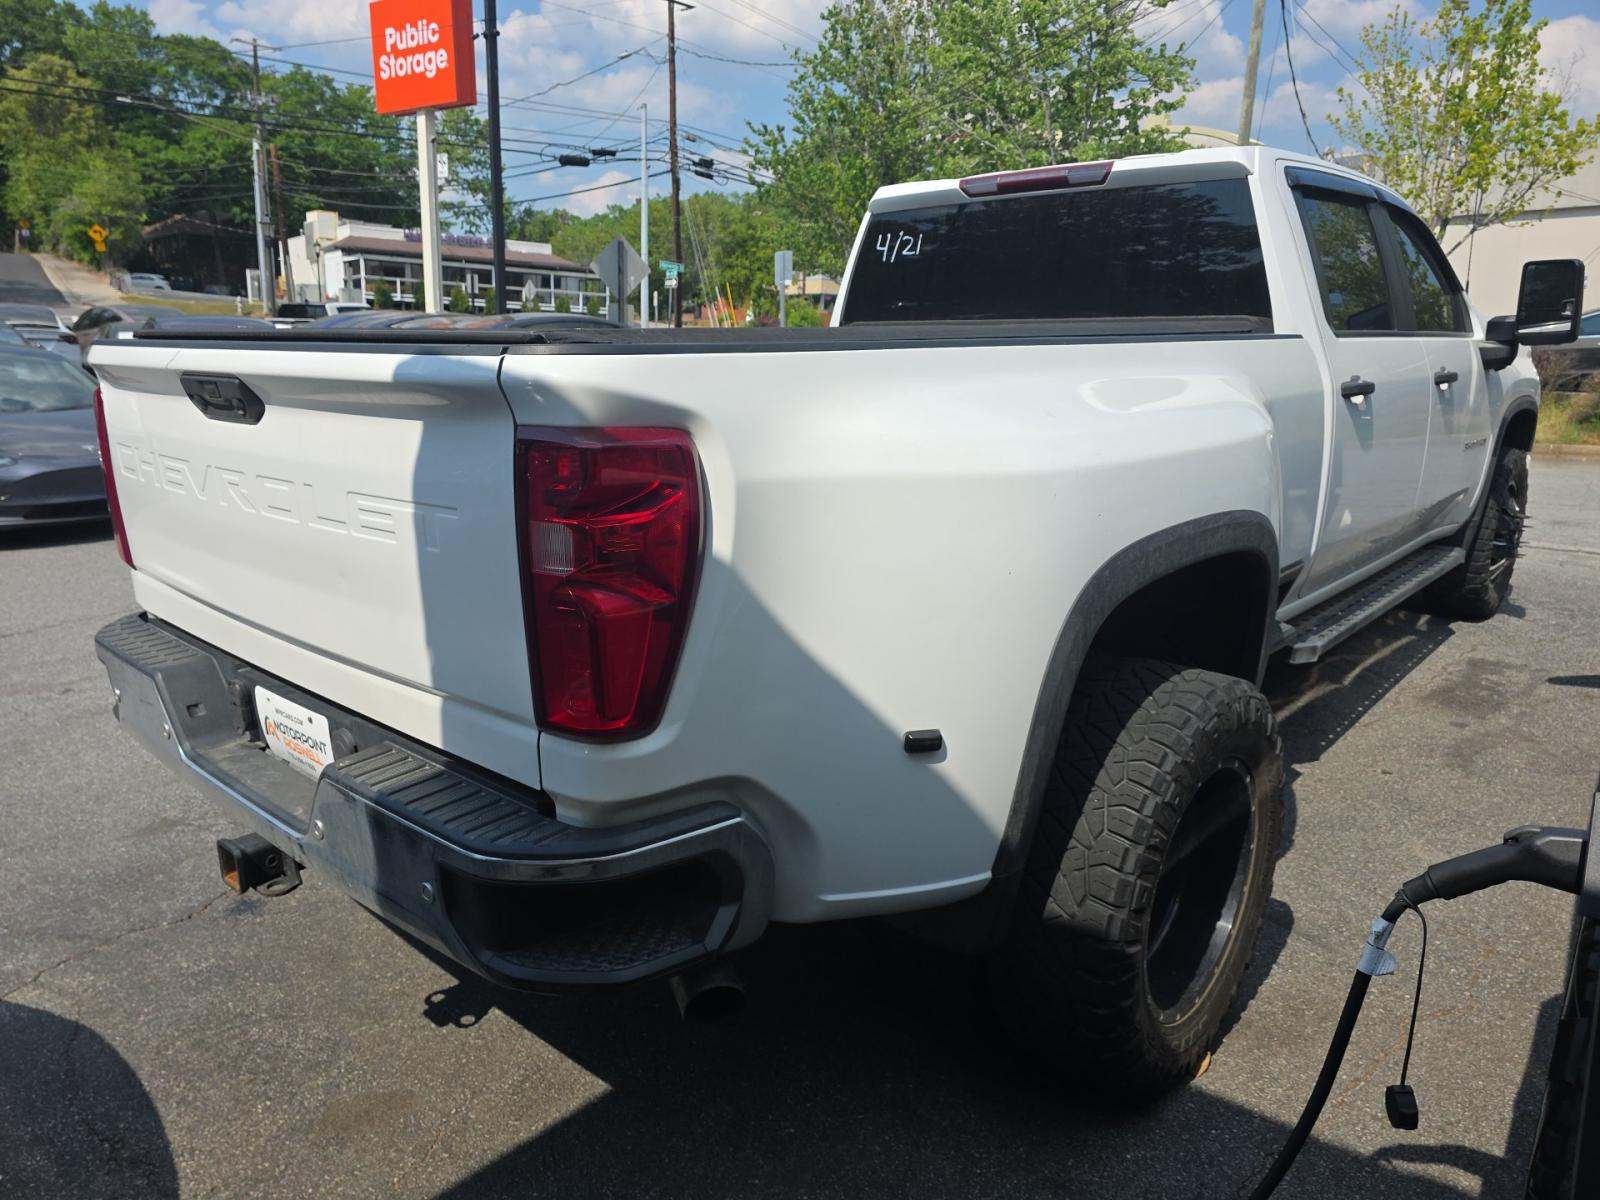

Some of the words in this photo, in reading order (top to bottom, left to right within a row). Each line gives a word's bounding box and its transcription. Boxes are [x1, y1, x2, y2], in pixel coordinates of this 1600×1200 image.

[385, 19, 440, 53] Public
[379, 48, 449, 80] Storage
[876, 230, 923, 263] 4/21
[116, 441, 459, 553] CHEVROLET
[273, 719, 327, 756] MOTORPOINT
